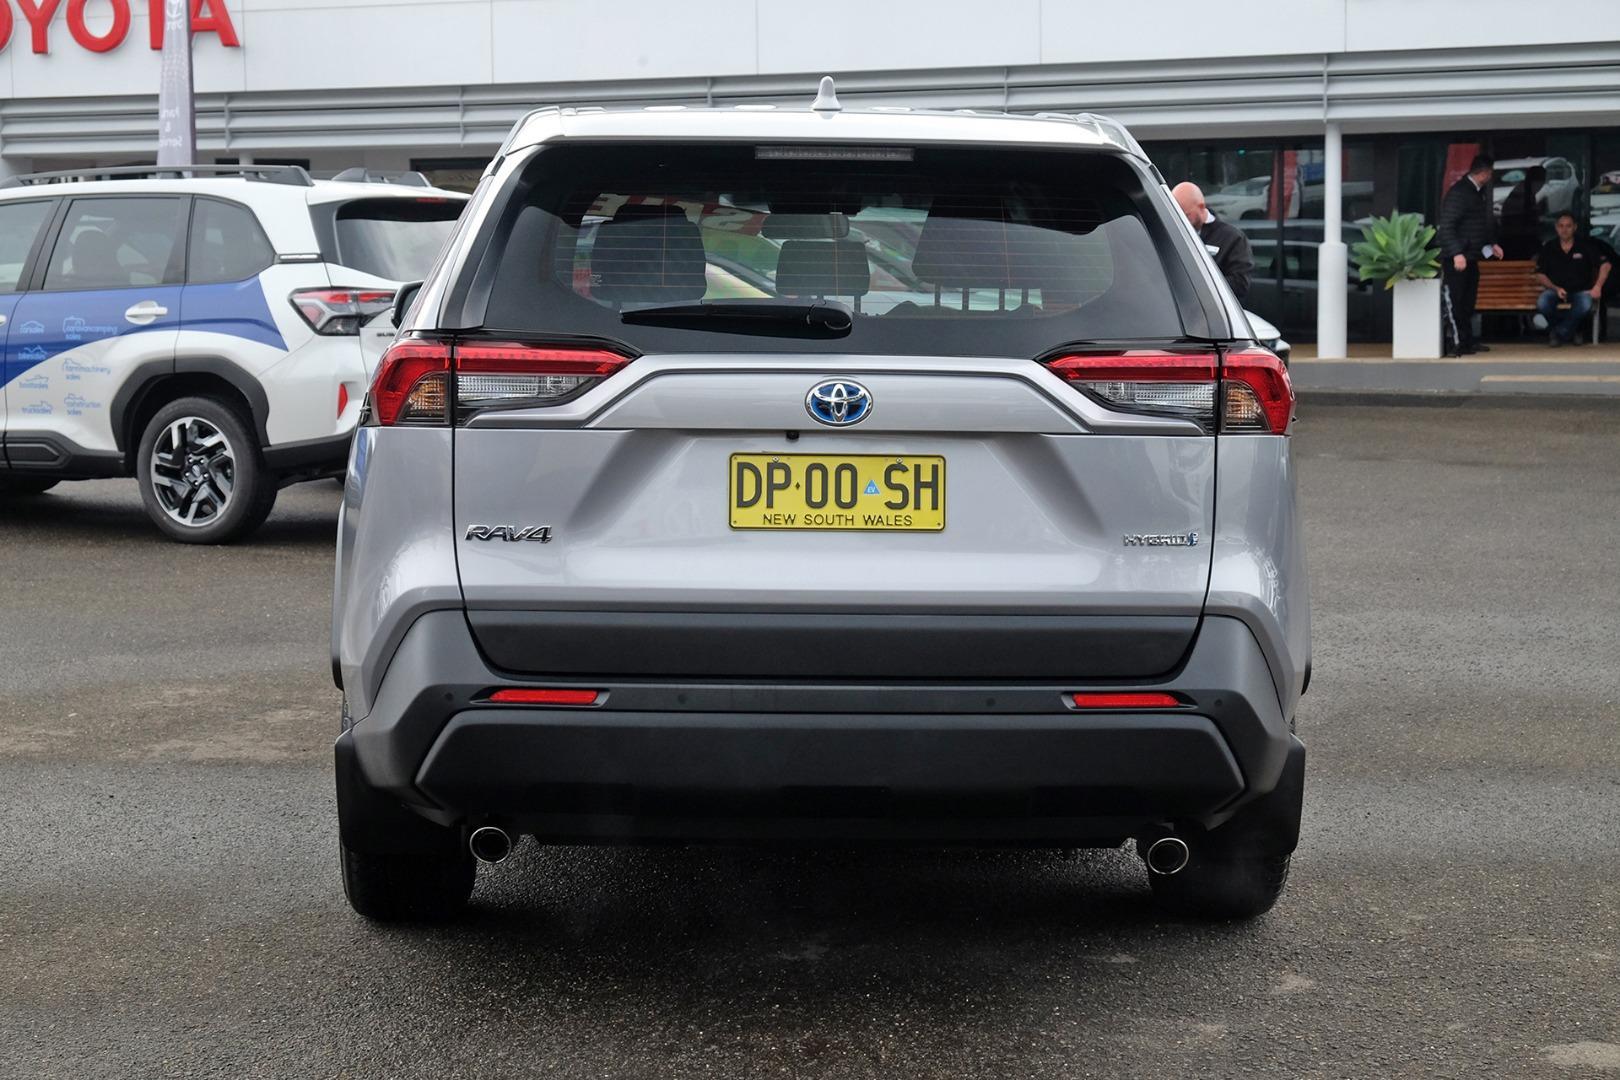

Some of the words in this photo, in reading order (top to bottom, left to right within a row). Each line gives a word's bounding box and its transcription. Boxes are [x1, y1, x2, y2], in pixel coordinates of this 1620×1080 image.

[736, 461, 792, 509] DP
[884, 463, 939, 511] SH
[763, 513, 796, 525] NEW
[804, 514, 854, 526] SOUTH
[863, 514, 913, 527] WALES
[464, 524, 552, 544] RAV4
[1123, 534, 1188, 547] HYBRID
